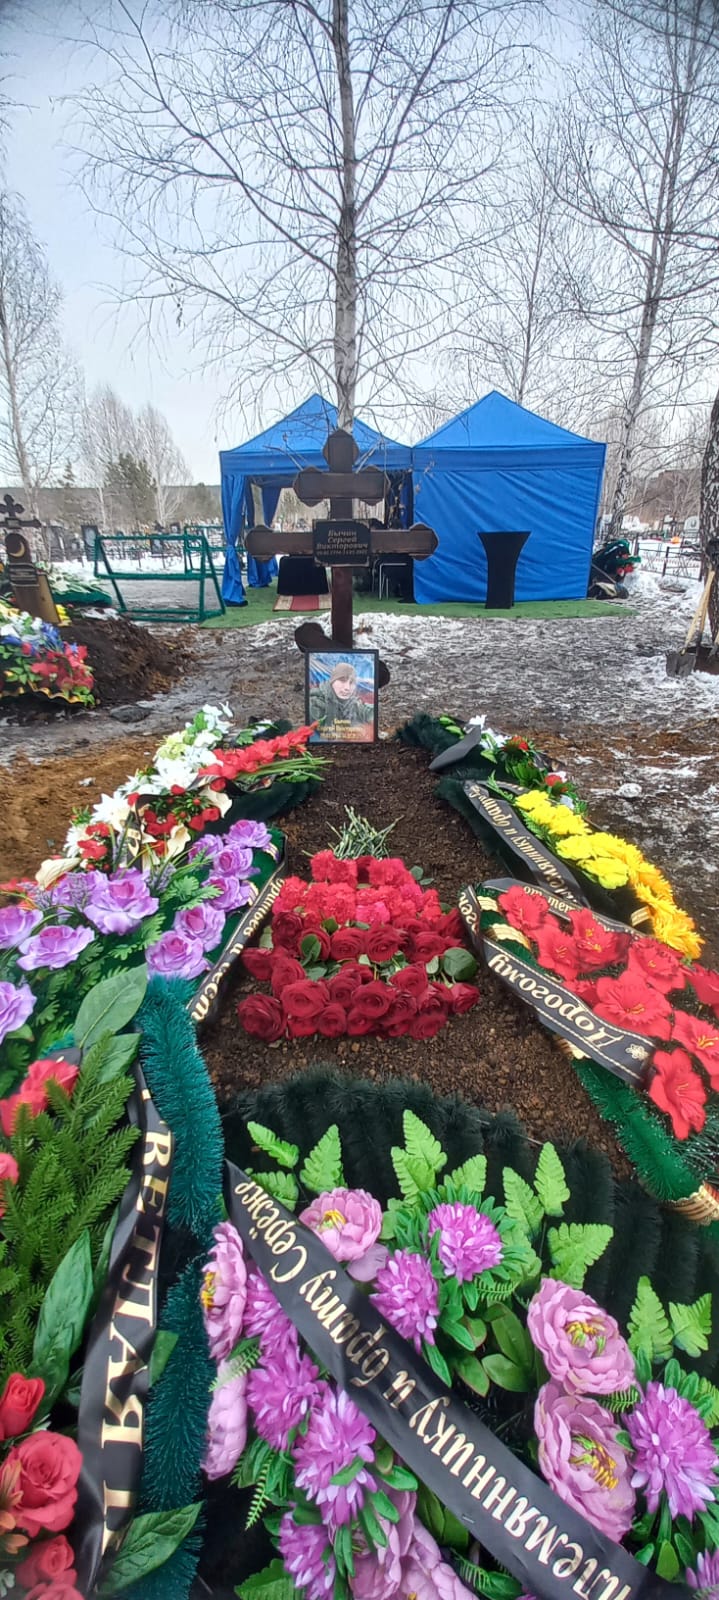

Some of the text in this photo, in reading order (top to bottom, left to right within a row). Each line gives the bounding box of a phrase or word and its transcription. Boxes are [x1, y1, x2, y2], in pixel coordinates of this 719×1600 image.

[316, 543, 369, 552] Викторович
[327, 537, 358, 545] Сергей
[229, 942, 245, 956] и
[191, 961, 231, 1021] сест
[488, 953, 625, 1049] Дорогому
[234, 1180, 308, 1284] Серёже
[102, 1118, 171, 1453] ВЕТЛАЯ
[299, 1269, 391, 1388] брату
[383, 1370, 417, 1409] и
